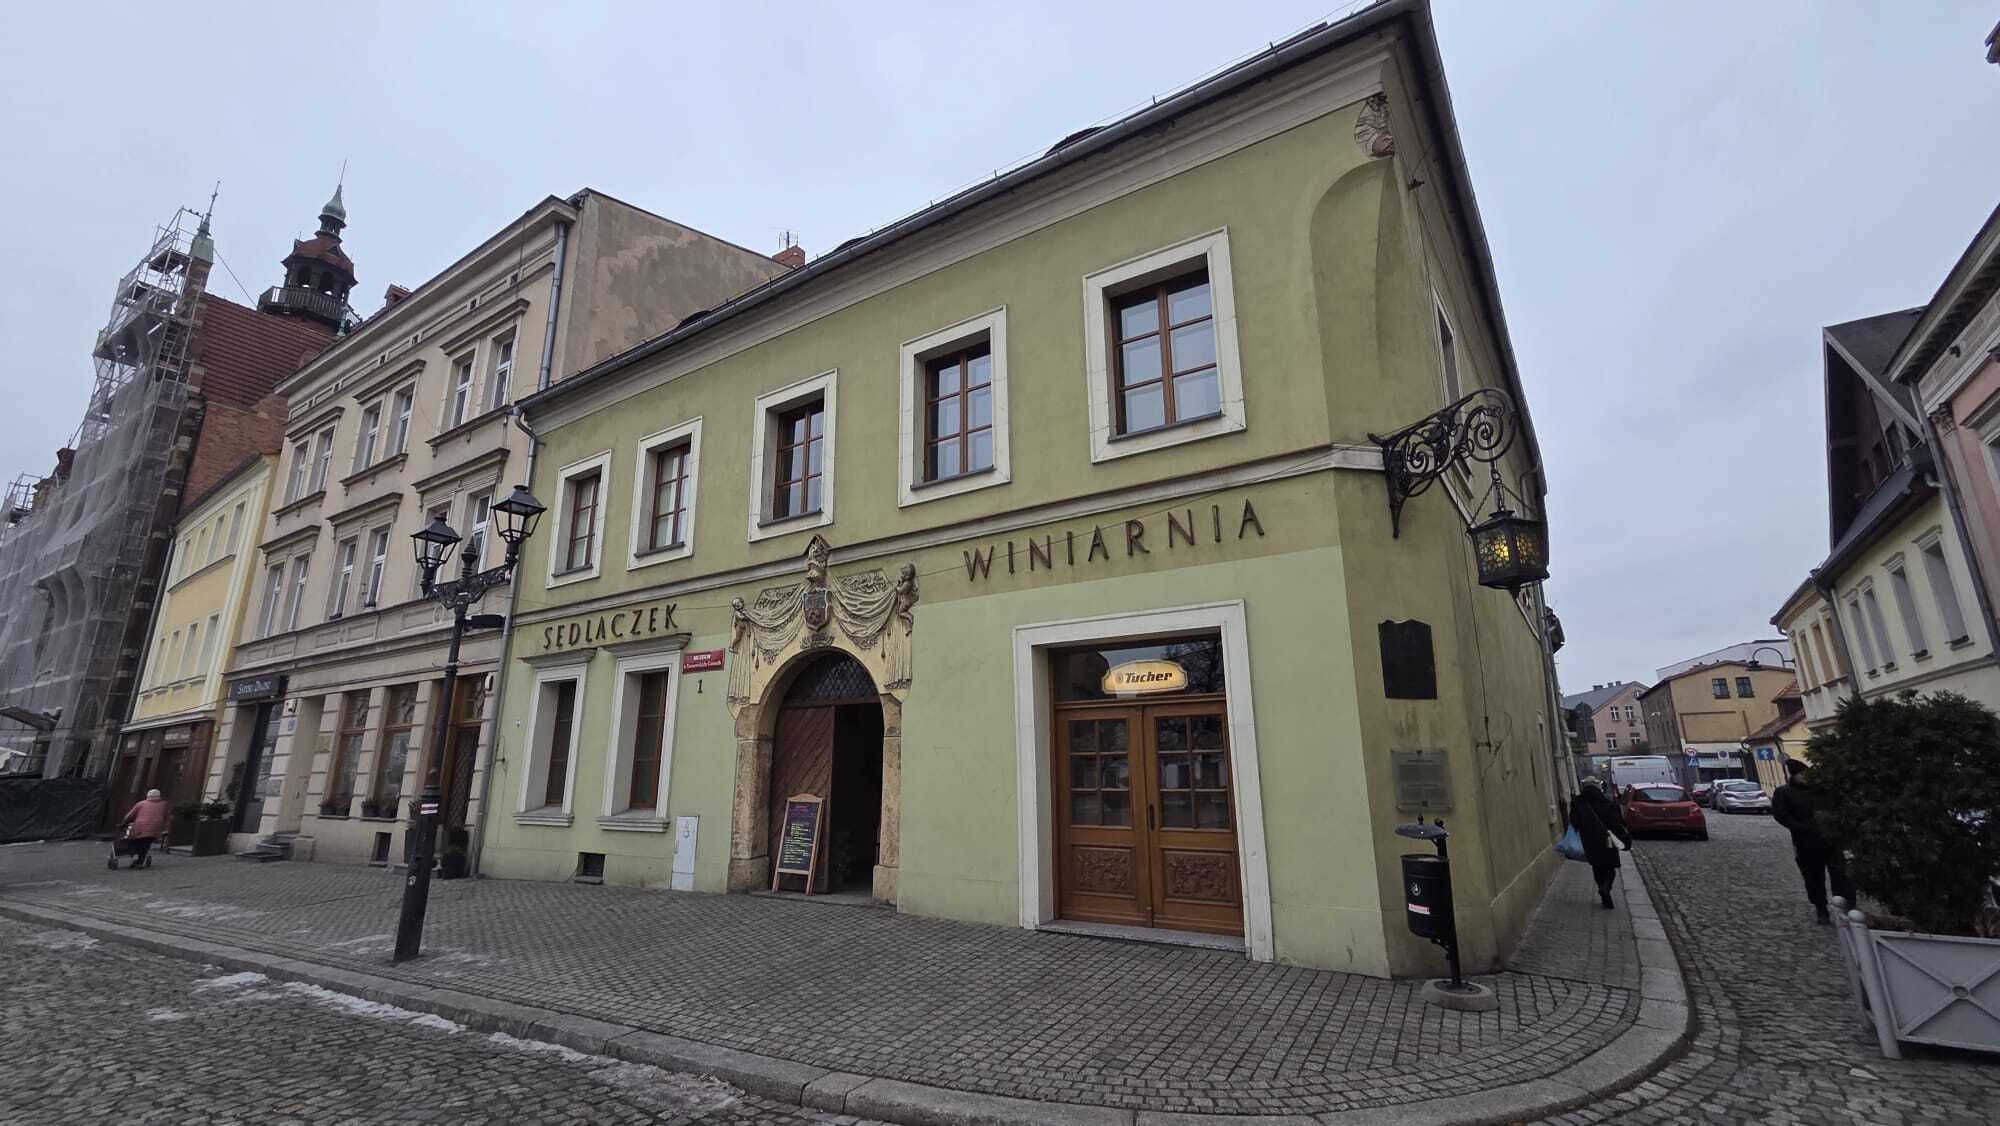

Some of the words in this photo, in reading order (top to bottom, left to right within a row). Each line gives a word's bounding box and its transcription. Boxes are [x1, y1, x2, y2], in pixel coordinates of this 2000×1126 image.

[963, 498, 1265, 582] WINIARNIA
[543, 603, 678, 649] SEDLACZEK
[697, 679, 703, 694] 1
[1125, 671, 1173, 684] Tucher
